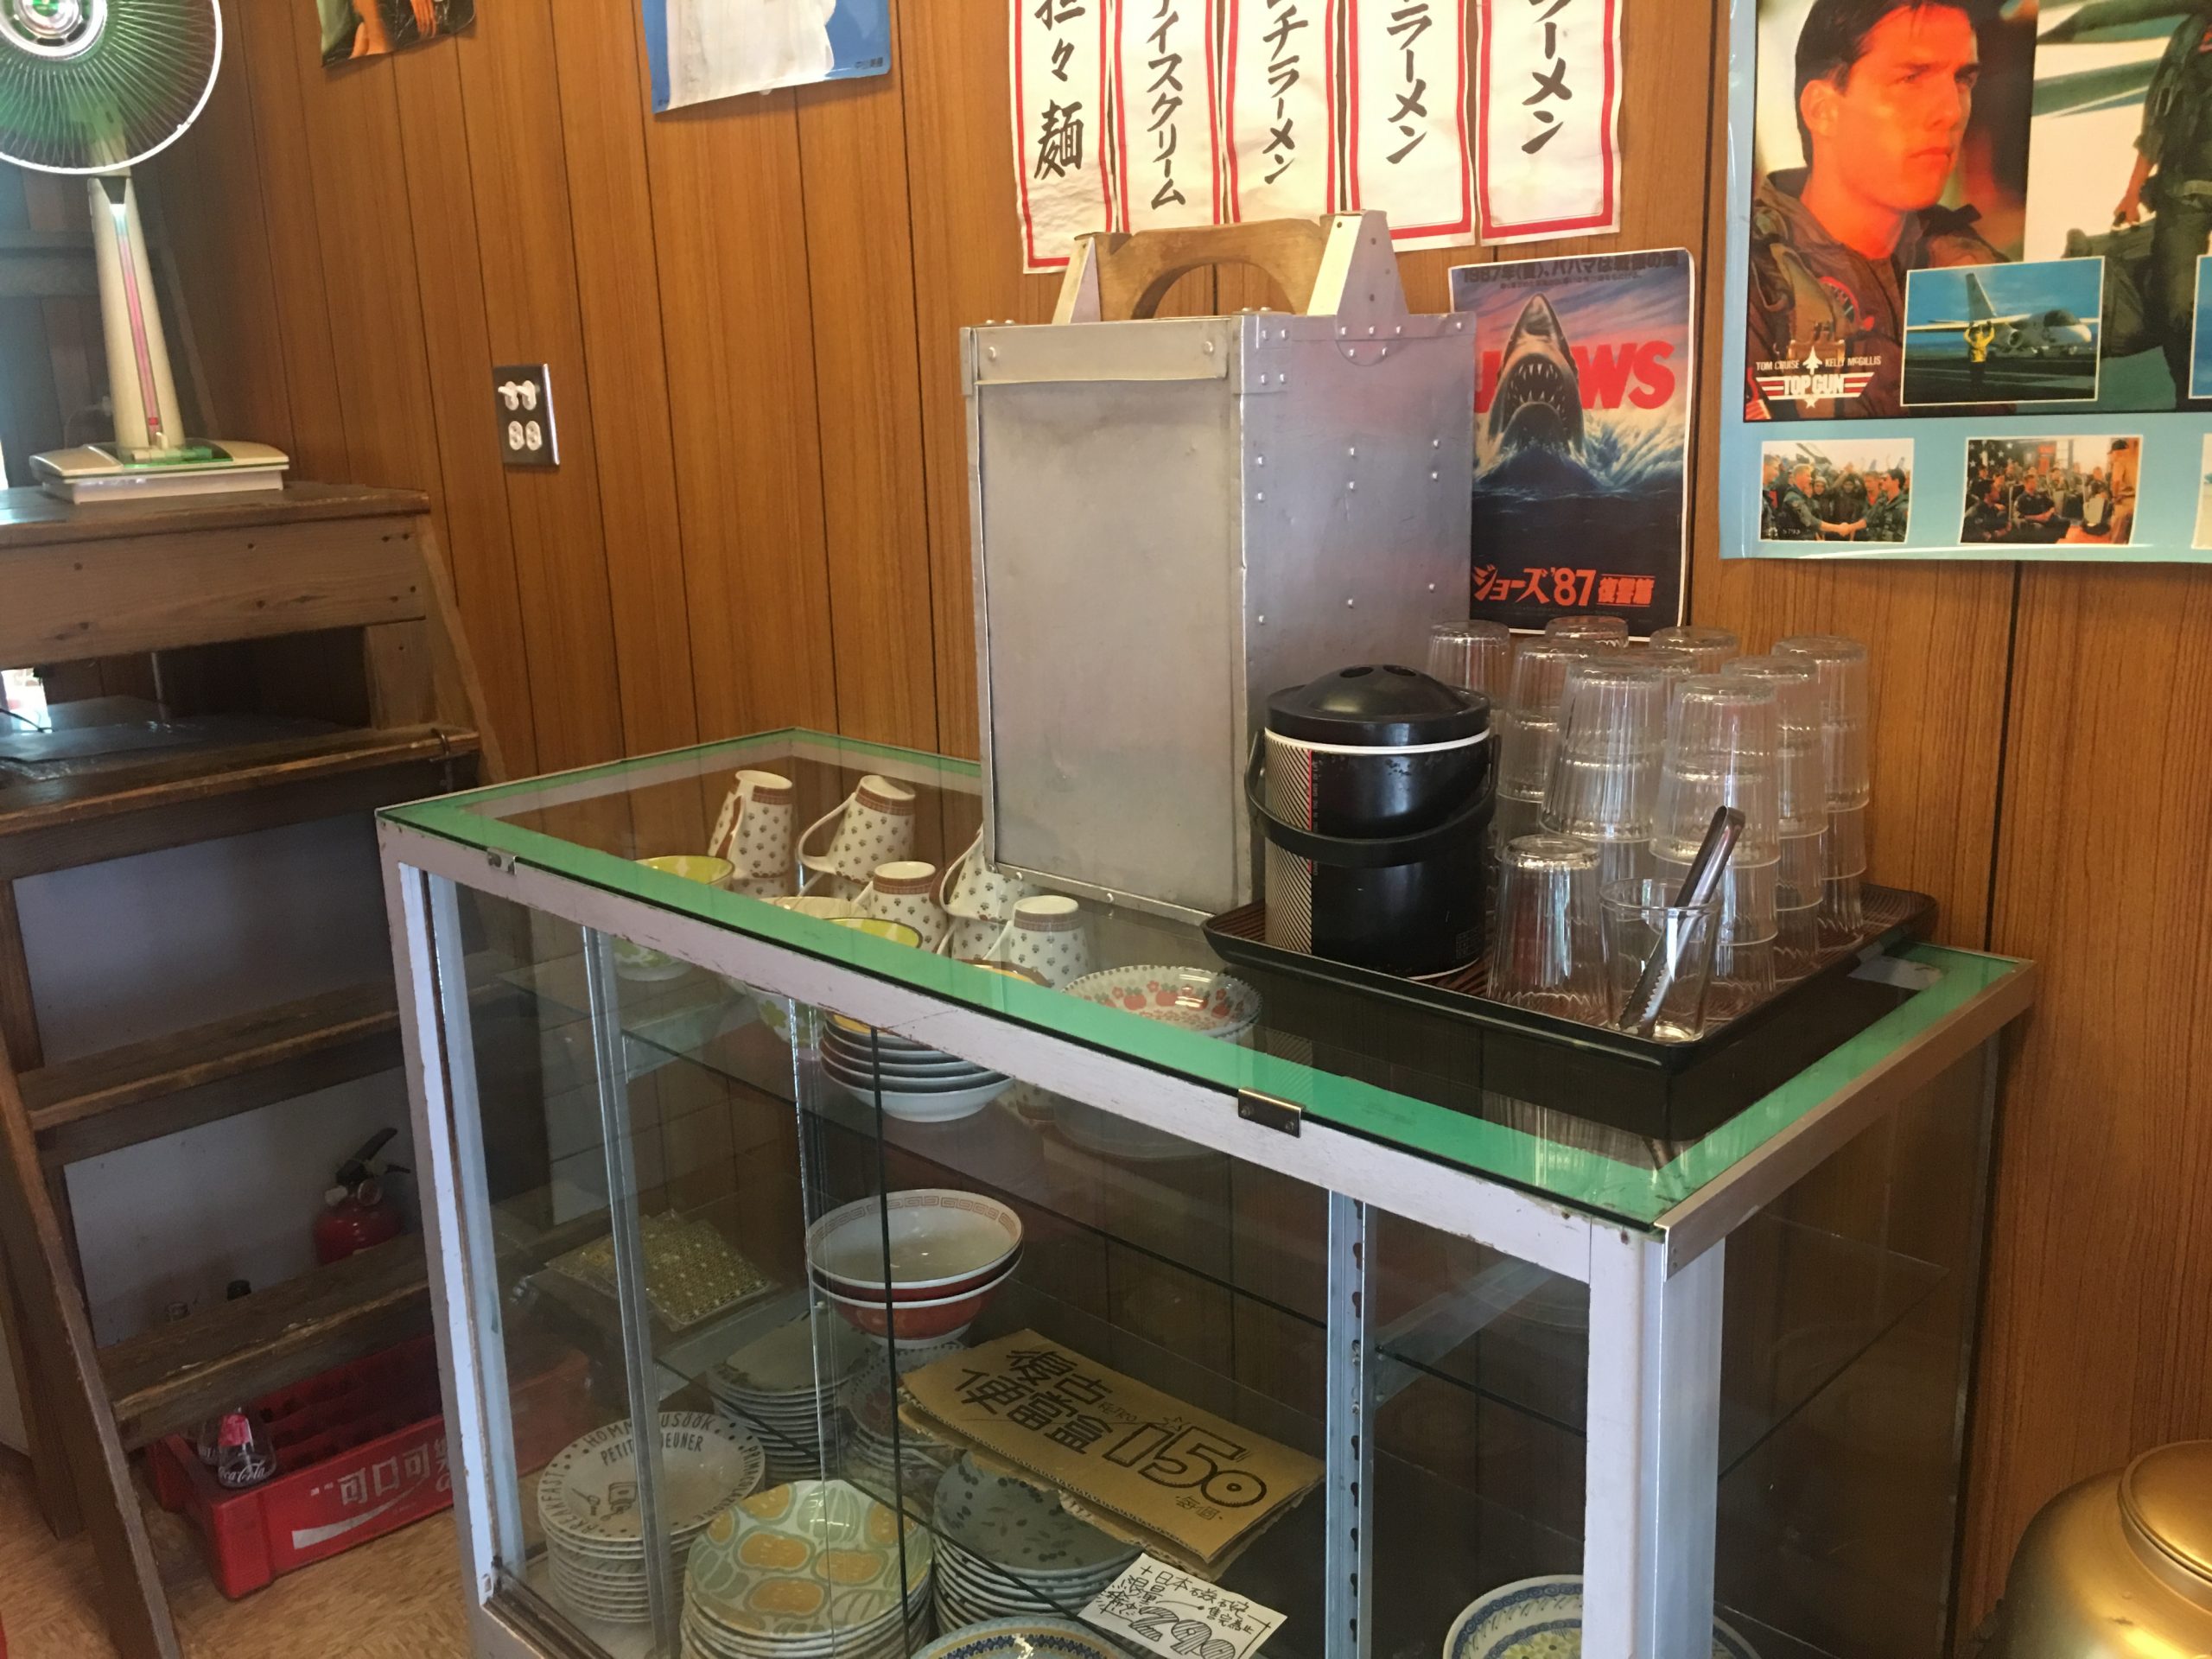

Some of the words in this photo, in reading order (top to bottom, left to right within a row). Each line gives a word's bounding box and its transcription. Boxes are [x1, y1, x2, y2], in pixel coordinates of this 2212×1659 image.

[1146, 0, 1186, 210] イスクリーム
[1262, 0, 1309, 185] チラーメン
[1473, 340, 1675, 414] JWS
[1756, 361, 1773, 372] TOM
[1774, 359, 1800, 371] CRUISE
[1825, 358, 1846, 368] KELLY
[1783, 375, 1811, 396] TOP
[1812, 373, 1845, 395] GUN
[954, 1368, 1114, 1455] 便當盒
[1006, 1350, 1113, 1405] 復古
[1102, 1421, 1268, 1508] 150
